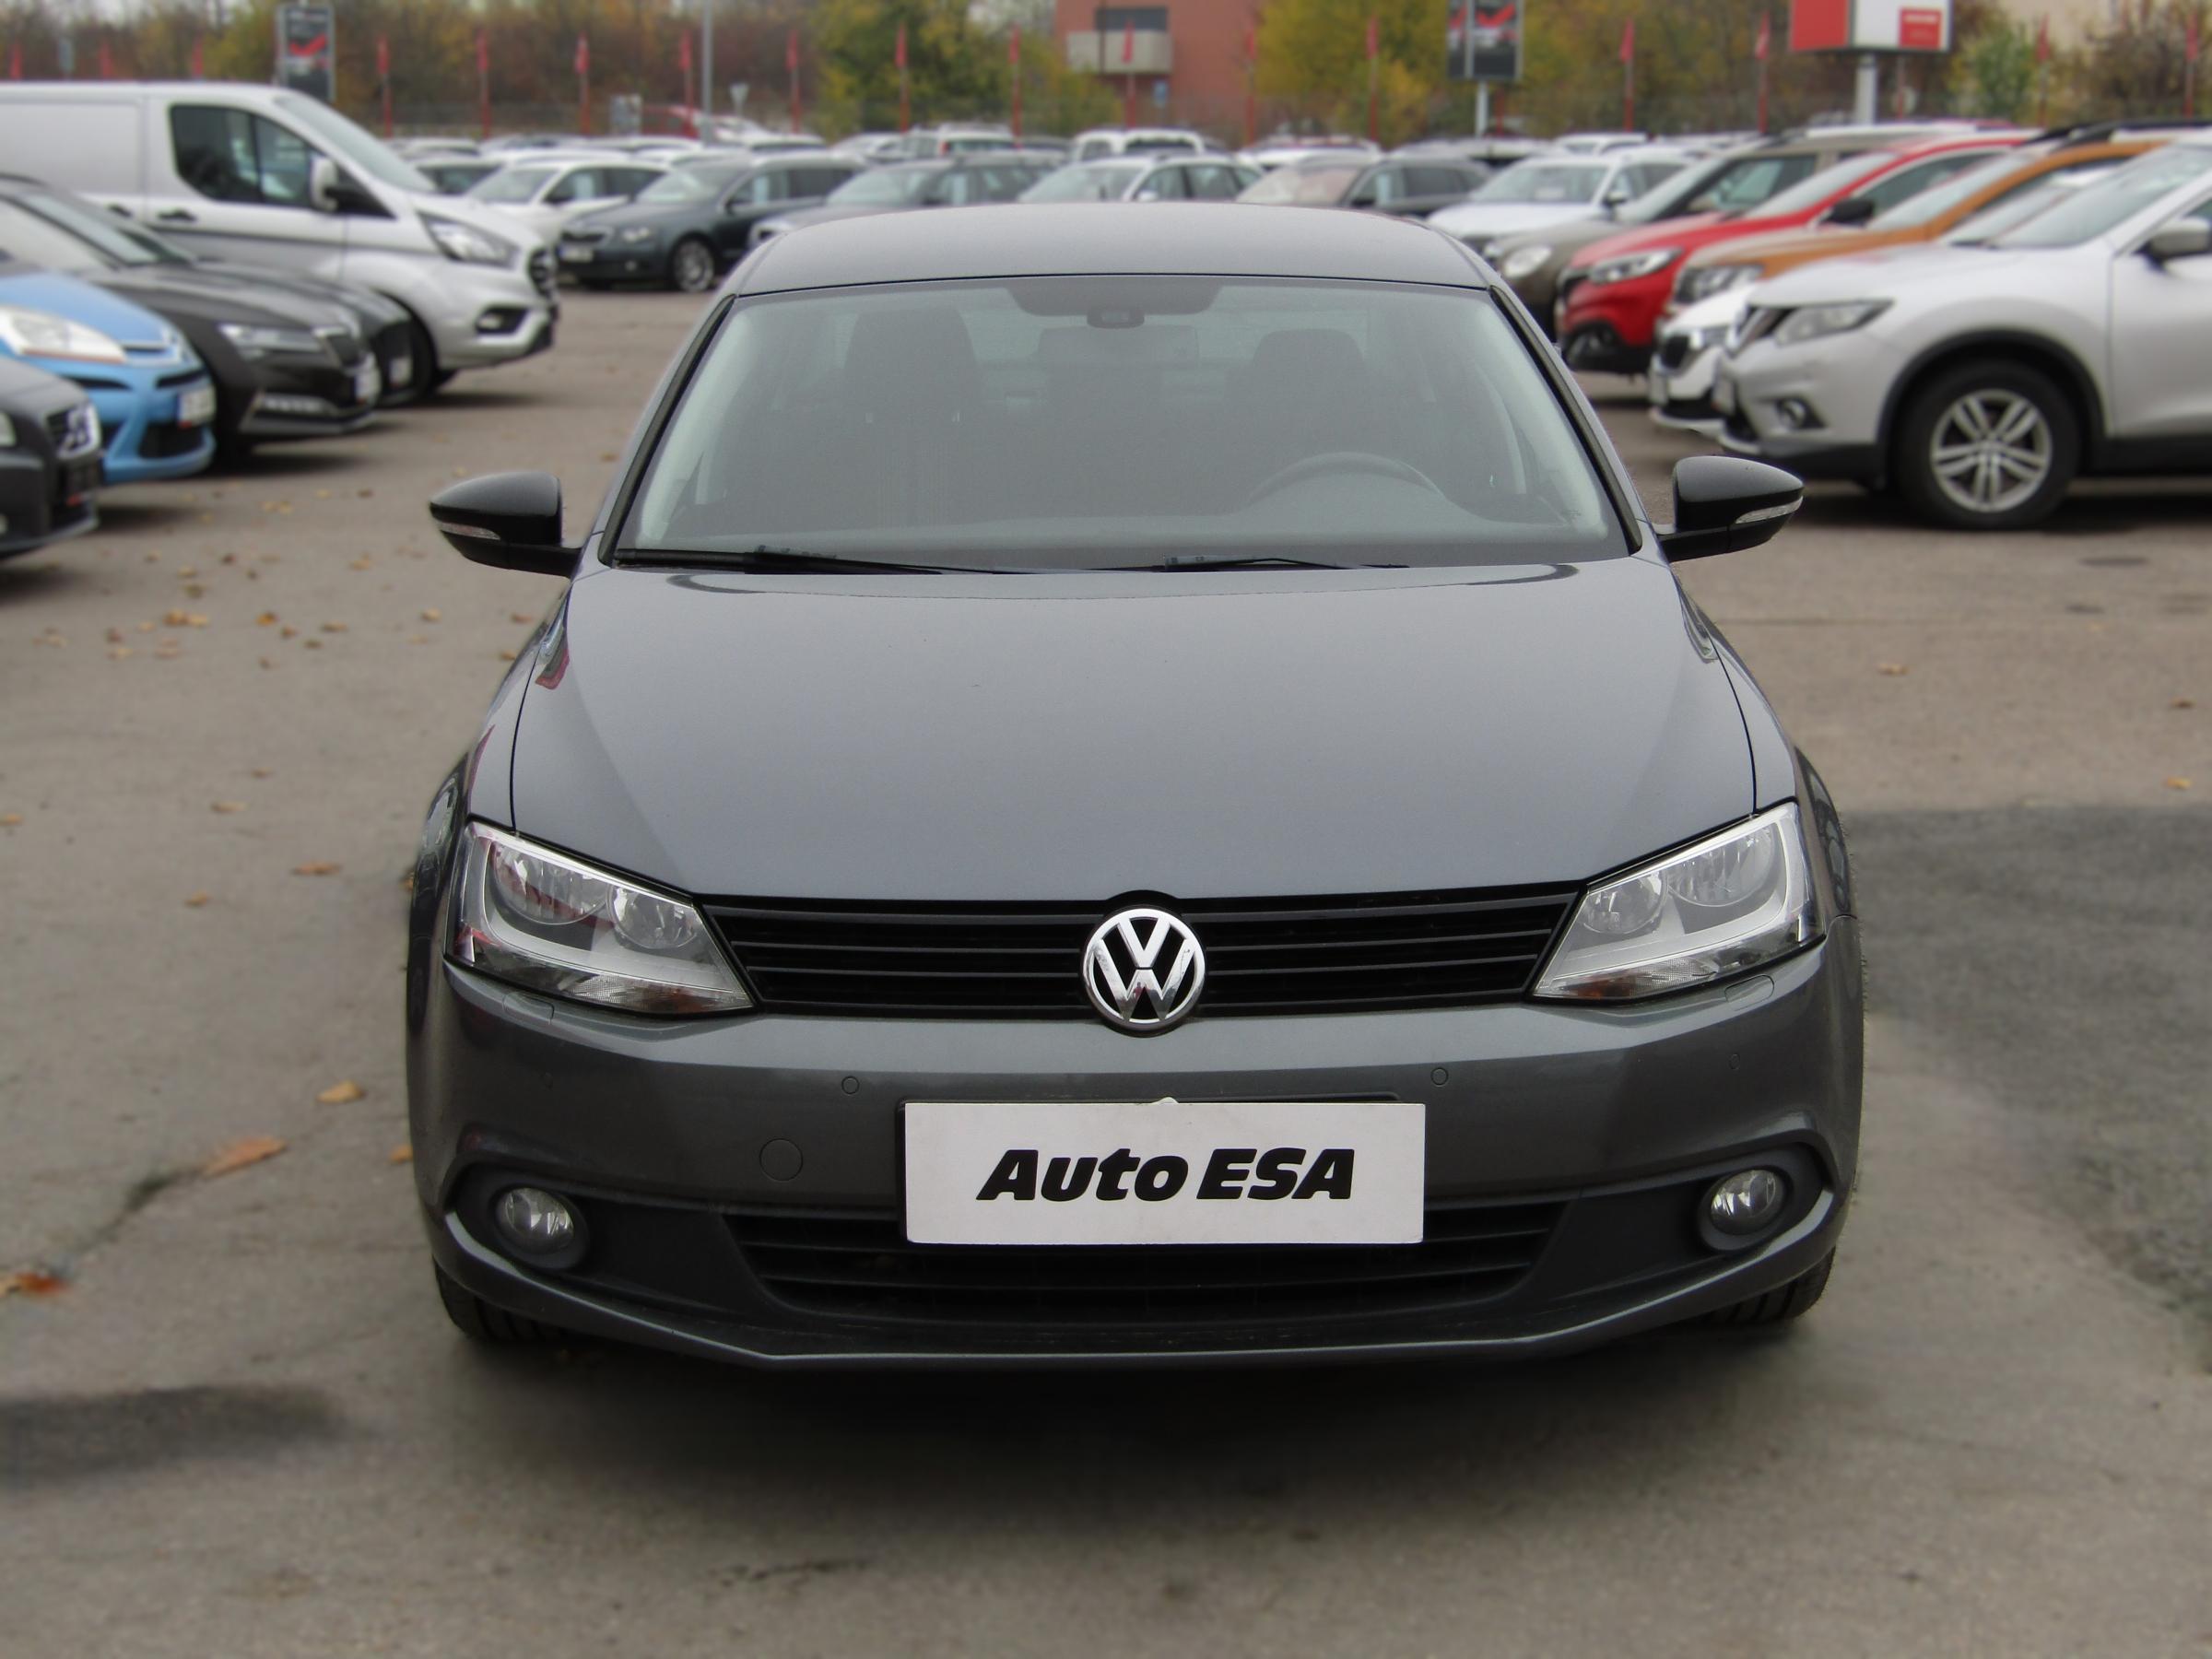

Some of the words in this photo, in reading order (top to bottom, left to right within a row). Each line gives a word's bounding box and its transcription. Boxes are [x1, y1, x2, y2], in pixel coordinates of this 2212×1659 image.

[1086, 910, 1202, 1025] VW
[976, 1147, 1189, 1203] Auto
[1195, 1147, 1355, 1201] ESA
